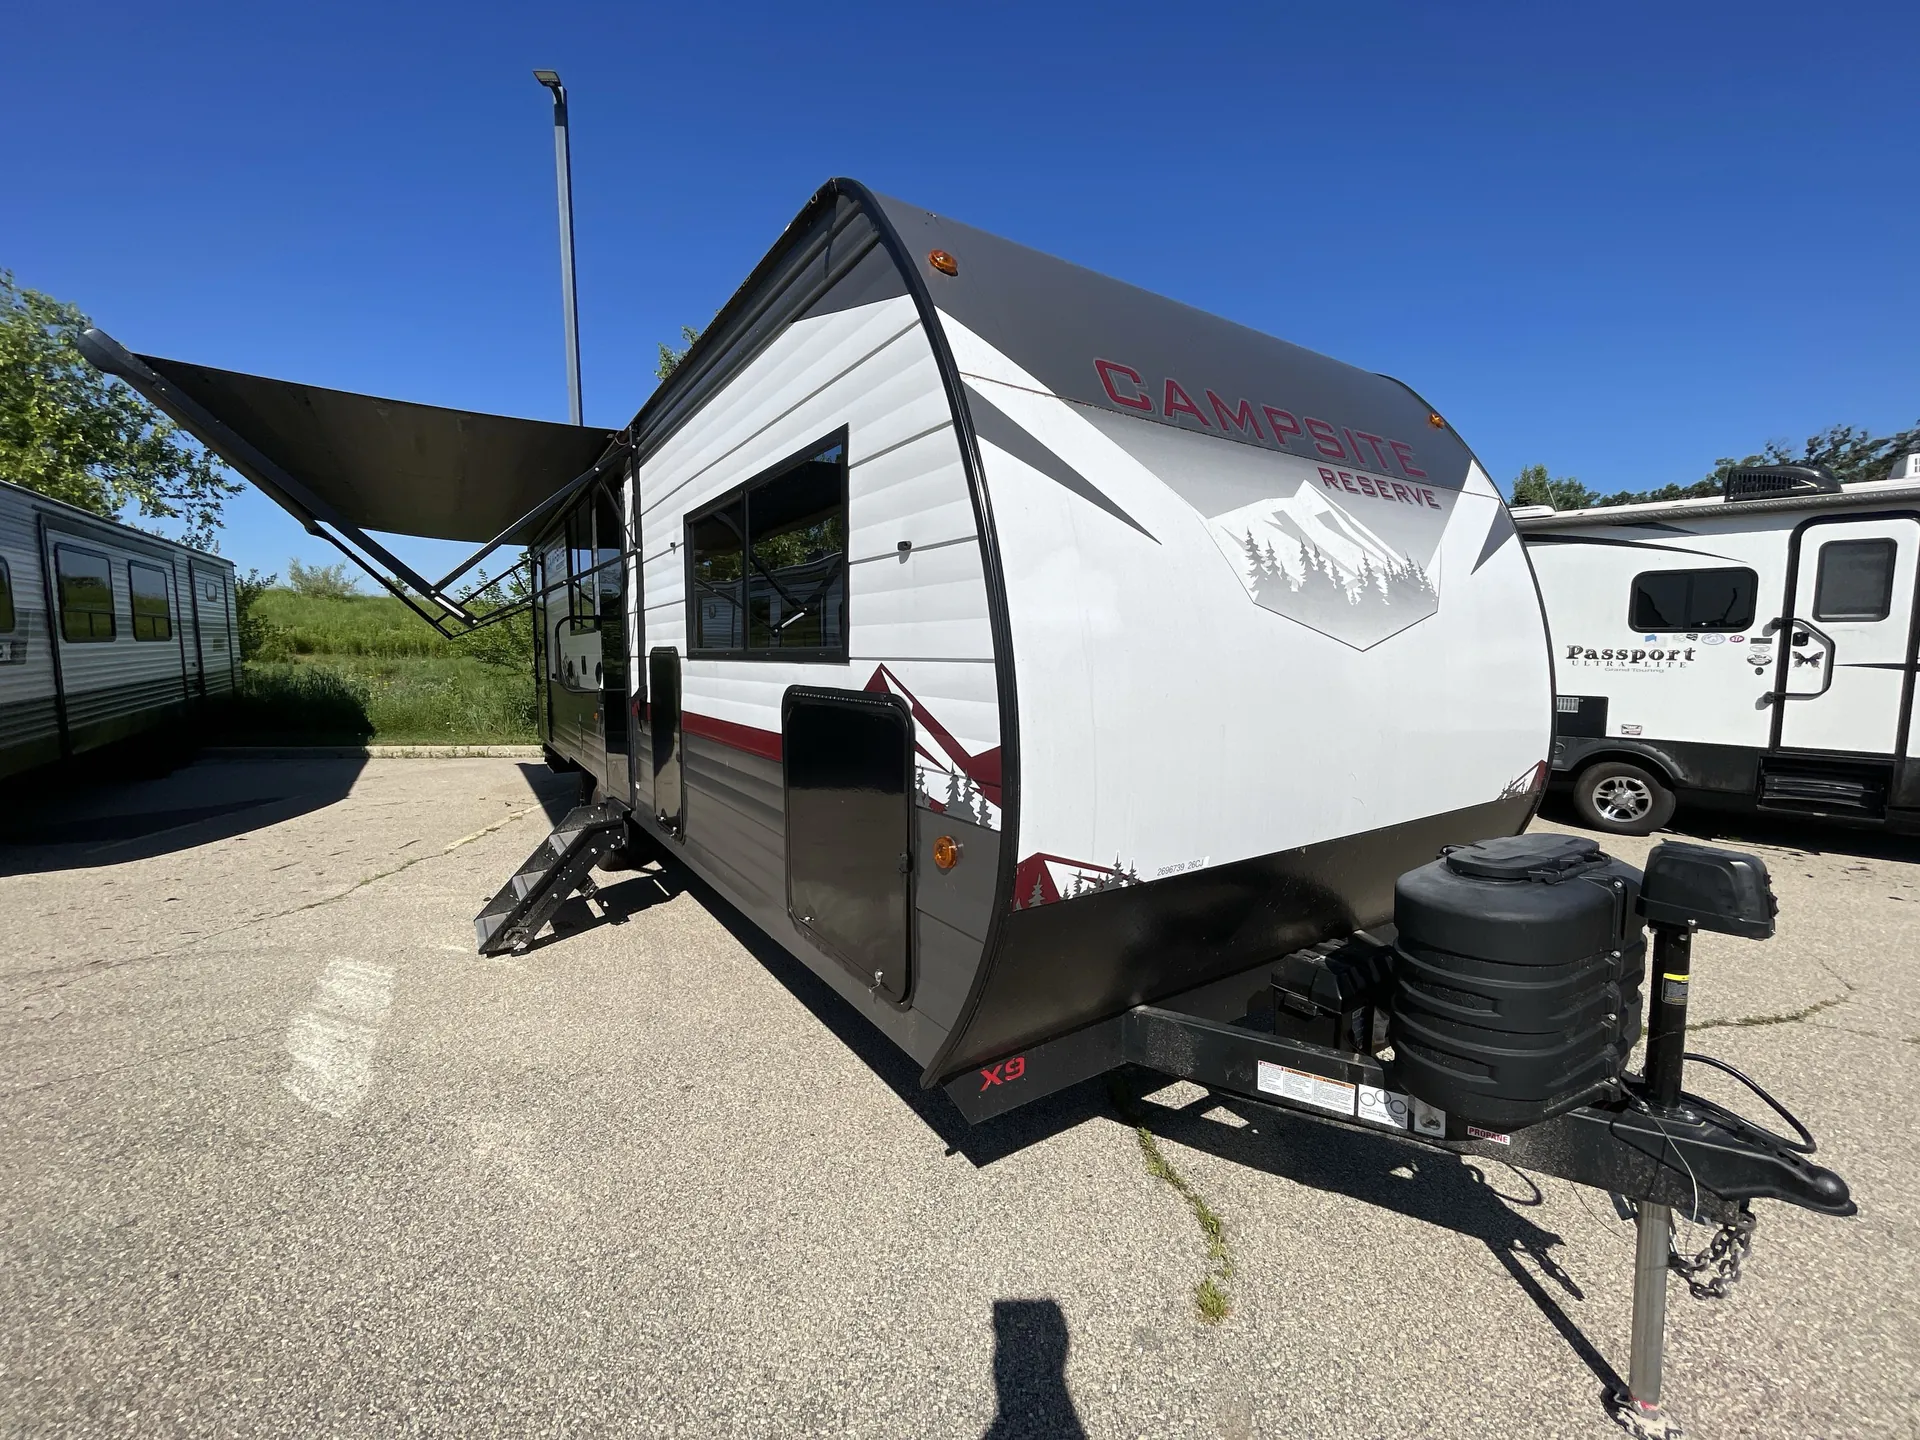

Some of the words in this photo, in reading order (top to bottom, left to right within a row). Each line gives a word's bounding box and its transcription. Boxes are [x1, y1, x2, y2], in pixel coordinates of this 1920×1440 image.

[1093, 358, 1427, 479] CAMPSITE
[1317, 467, 1442, 510] RESERVE
[1566, 645, 1696, 664] Passport
[1644, 661, 1687, 669] LITE
[980, 1056, 1025, 1092] X9
[1469, 1127, 1509, 1143] PROPANE
